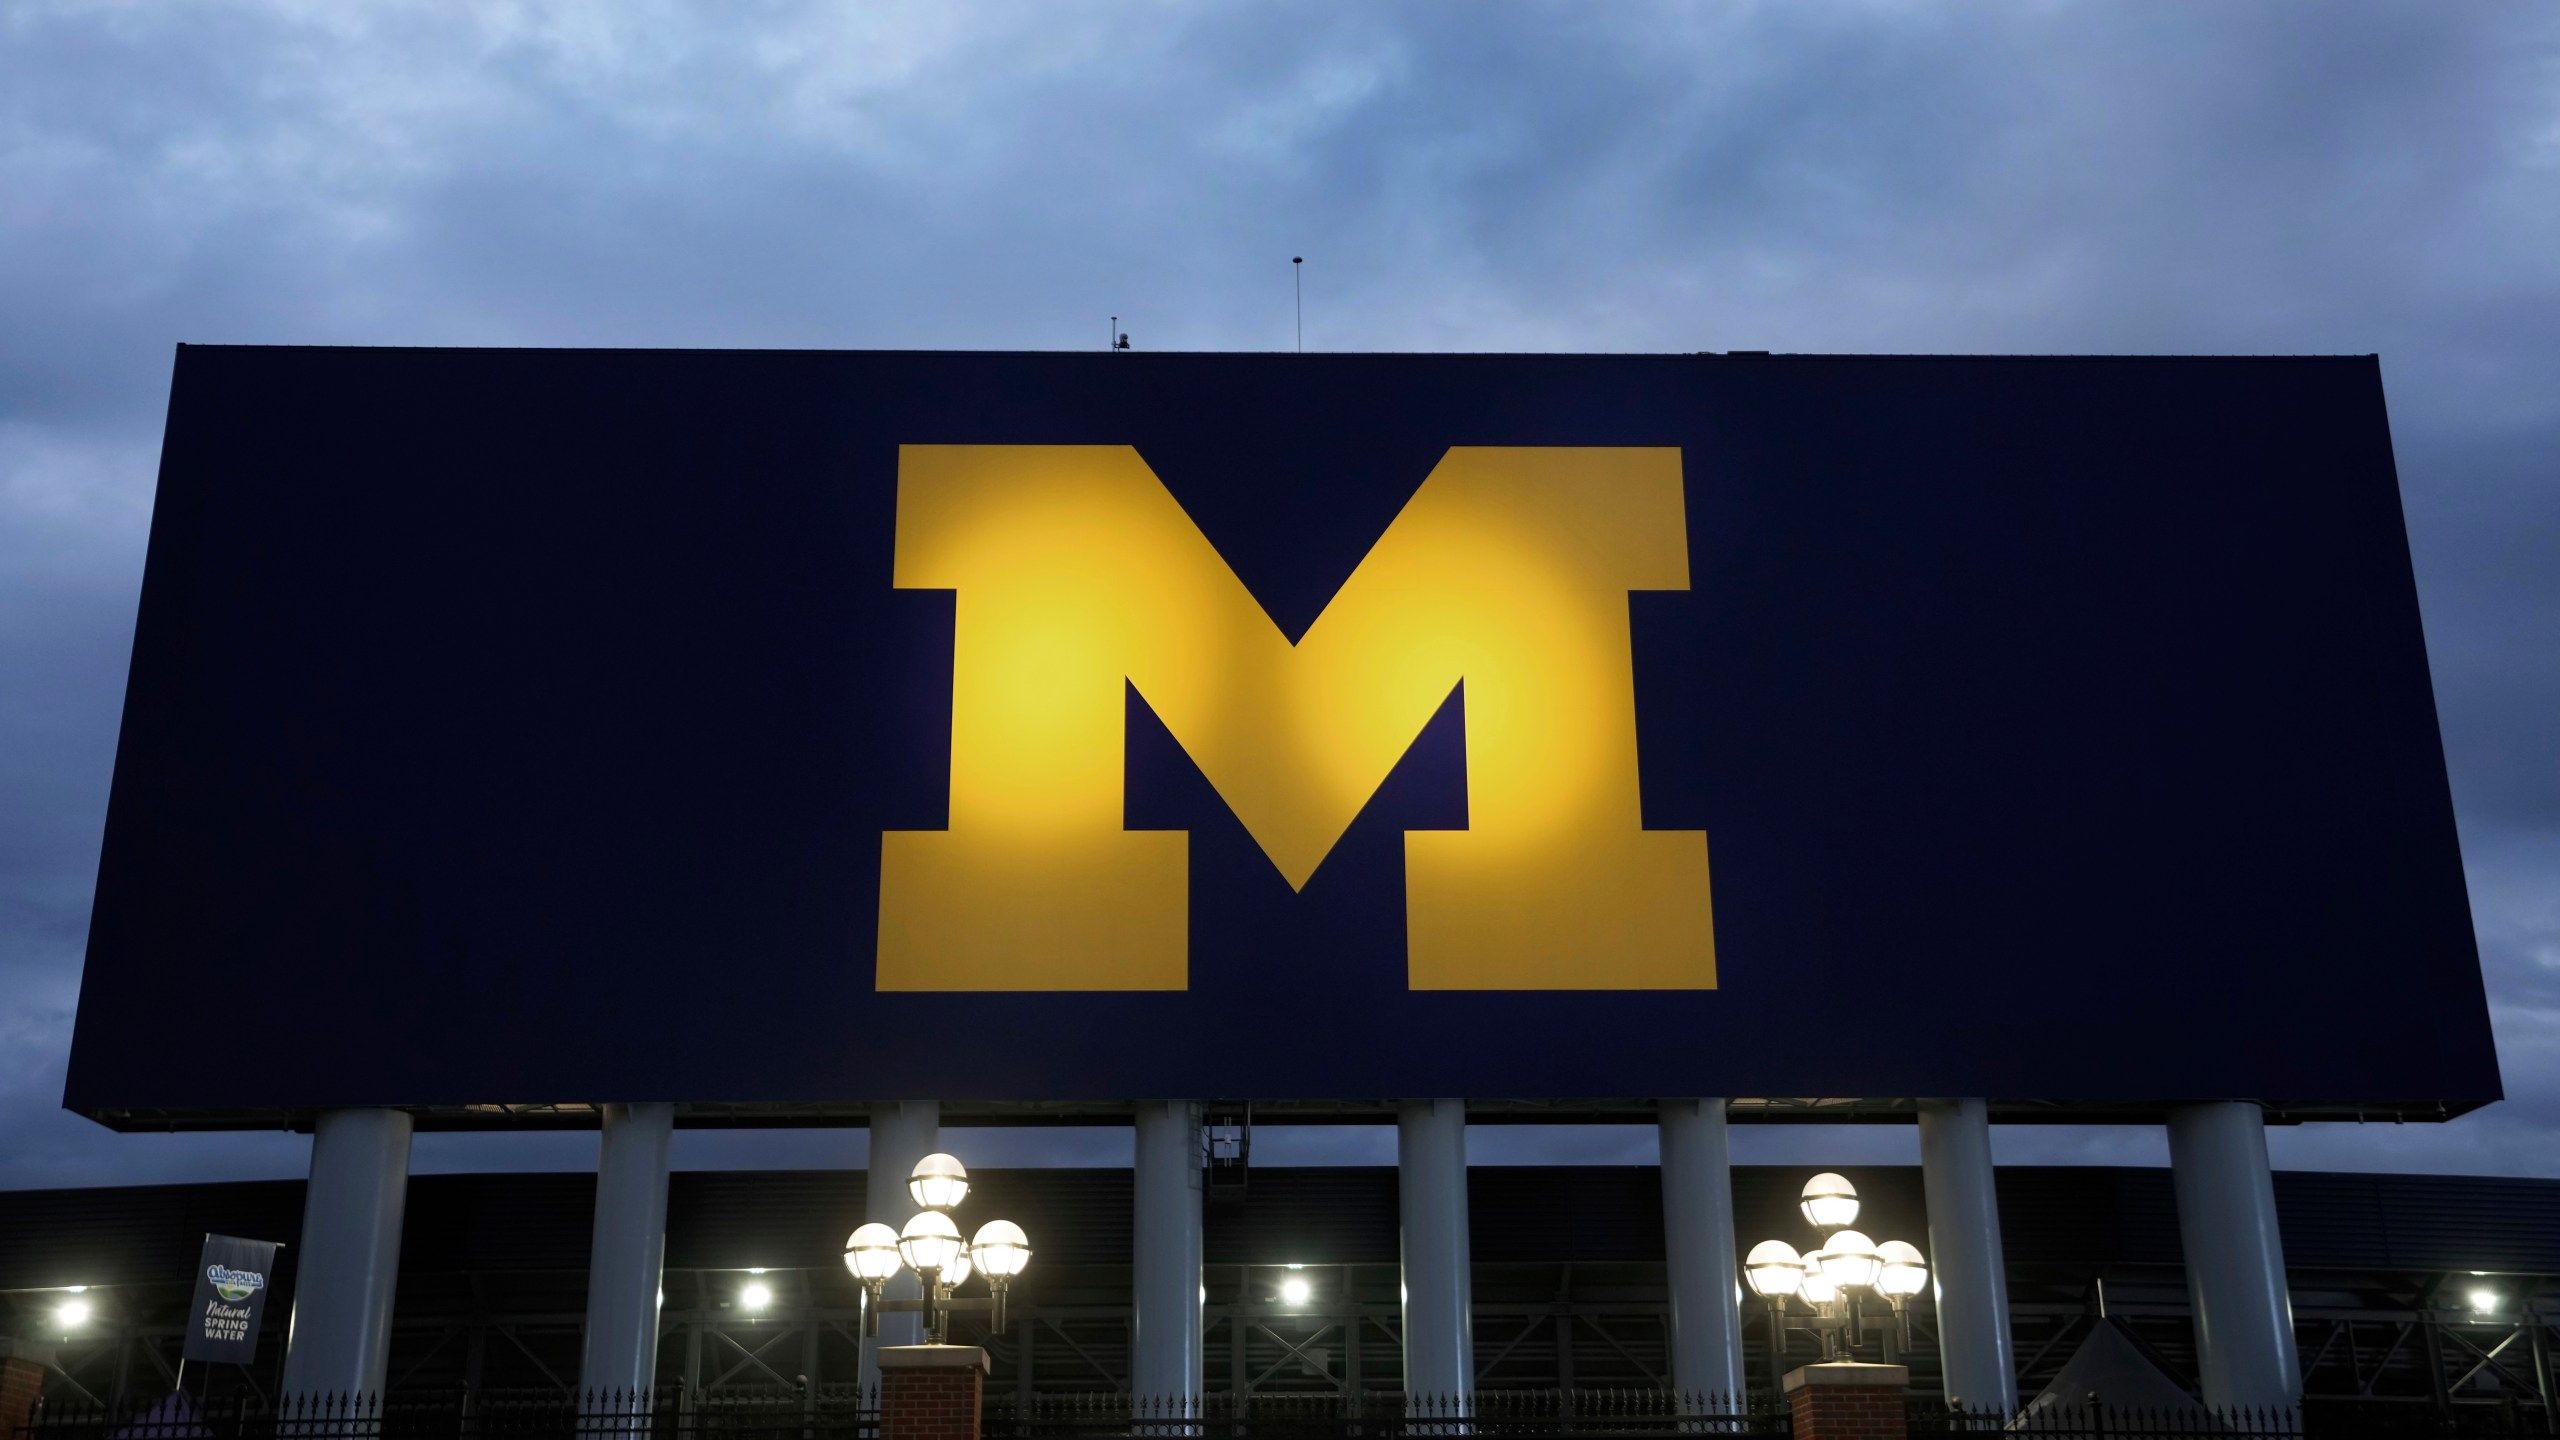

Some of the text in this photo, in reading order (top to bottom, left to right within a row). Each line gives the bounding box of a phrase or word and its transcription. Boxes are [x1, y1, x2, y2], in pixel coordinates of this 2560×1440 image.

[876, 445, 1717, 991] M
[206, 1300, 251, 1319] Natural
[205, 1317, 248, 1330] SPRING
[205, 1328, 245, 1340] WATER
